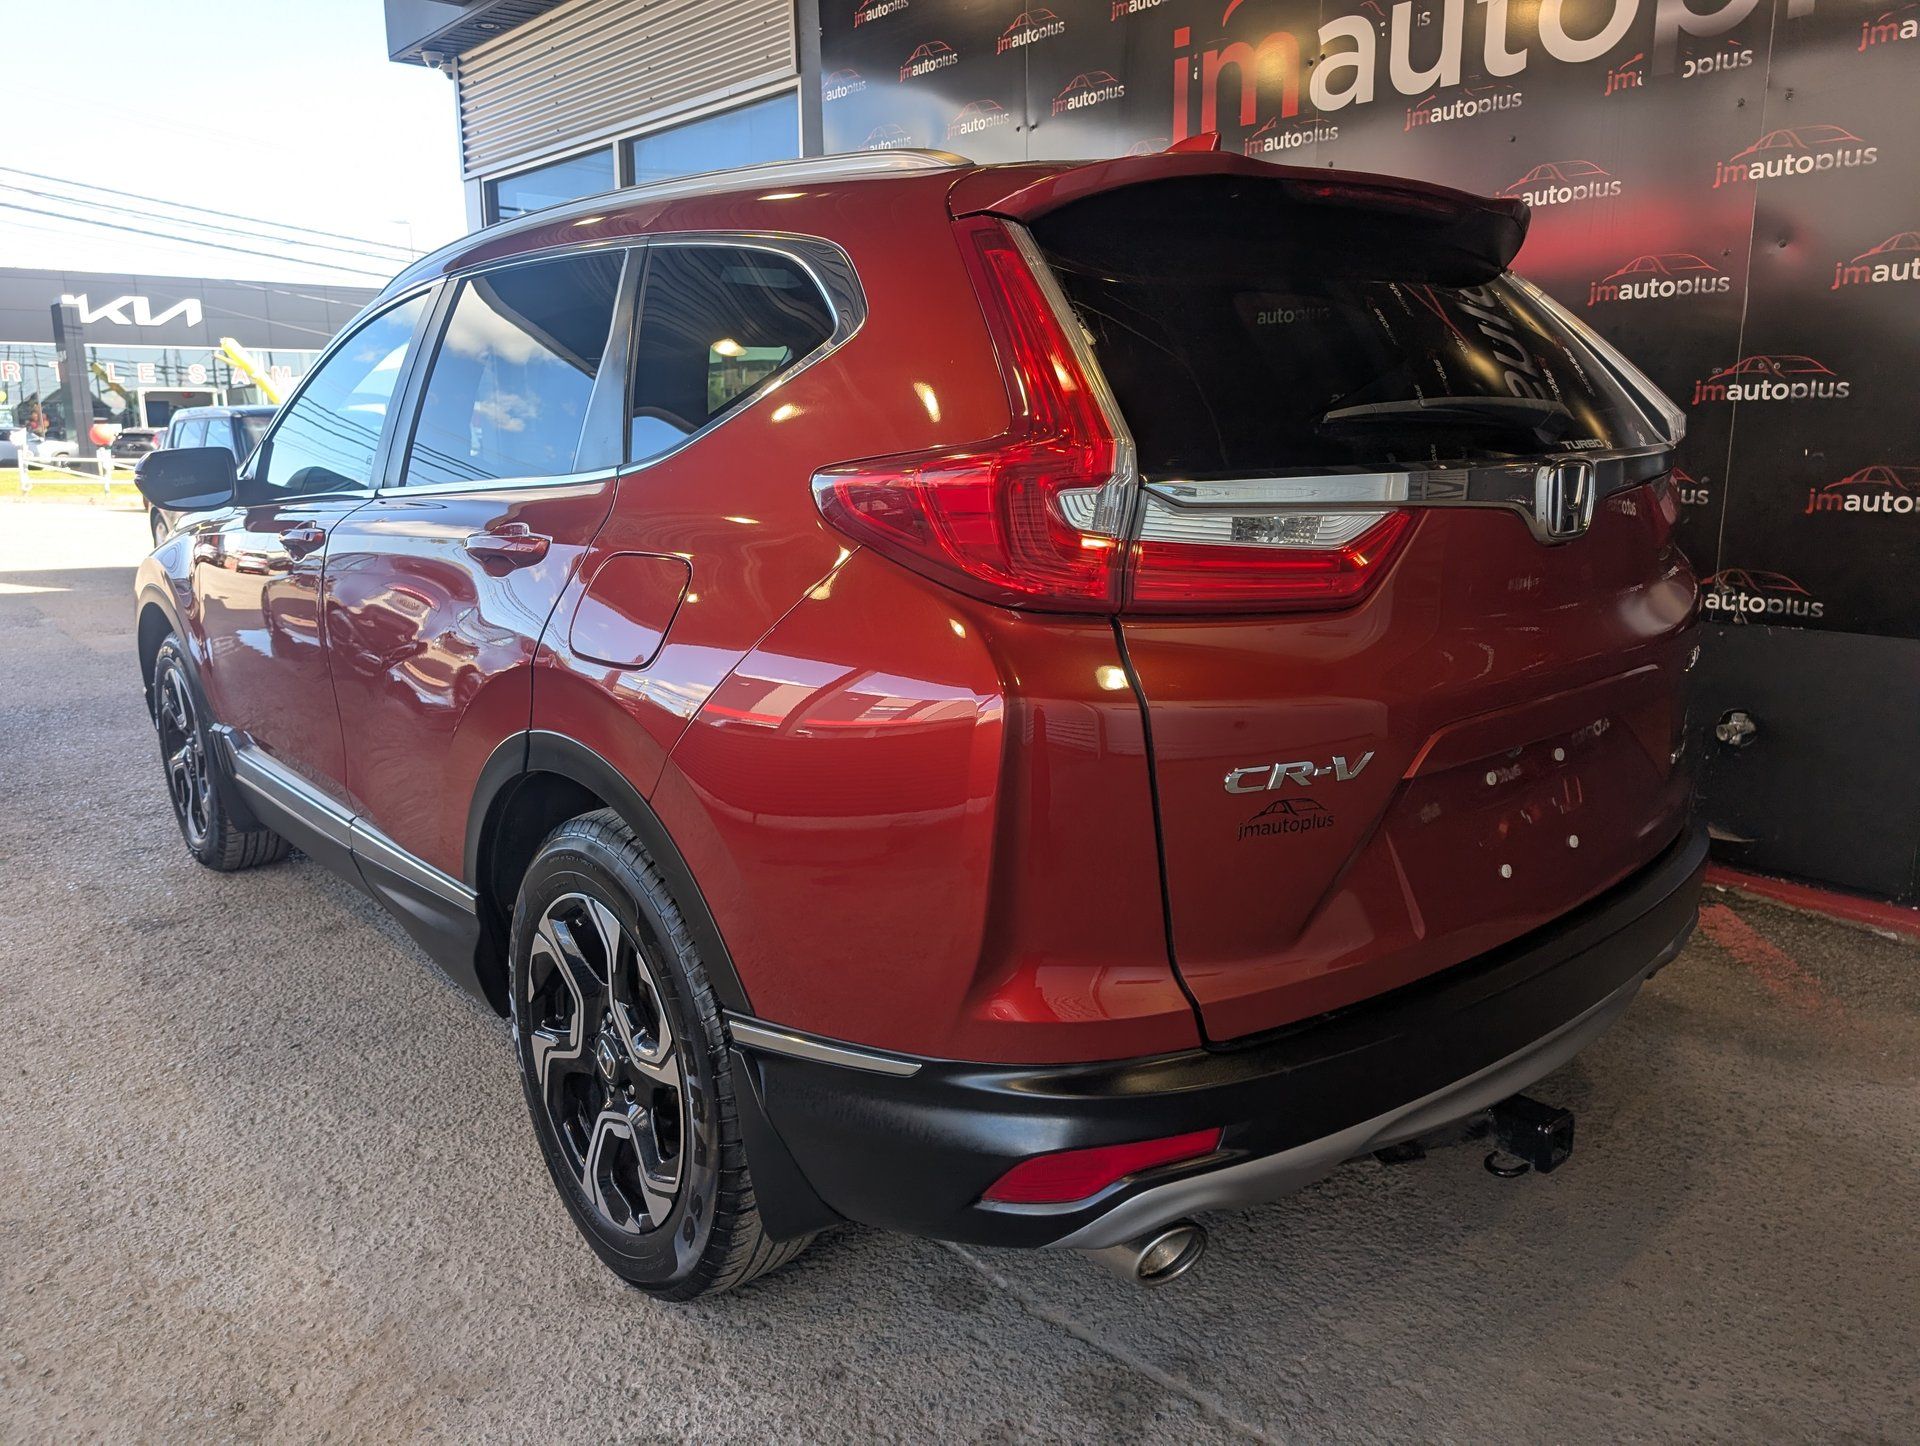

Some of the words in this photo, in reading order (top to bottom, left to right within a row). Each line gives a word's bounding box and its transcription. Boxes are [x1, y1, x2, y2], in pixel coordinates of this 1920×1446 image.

[996, 21, 1065, 55] jmautoplus
[900, 53, 958, 83] jmautoplus
[823, 80, 866, 101] autoplus
[1051, 84, 1125, 117] jmautoplus
[946, 112, 1010, 140] jmautoplus
[1404, 91, 1523, 132] jmautoplus
[1244, 125, 1339, 156] jmautoplus
[1712, 147, 1878, 188] jmautoplus
[1587, 275, 1730, 306] jmautoplus
[1692, 379, 1850, 406] jmautoplus
[1805, 487, 1920, 514] jmauto
[1705, 591, 1824, 618] autoplus
[1224, 751, 1376, 794] CR-V
[1237, 812, 1335, 841] jmautoplus
